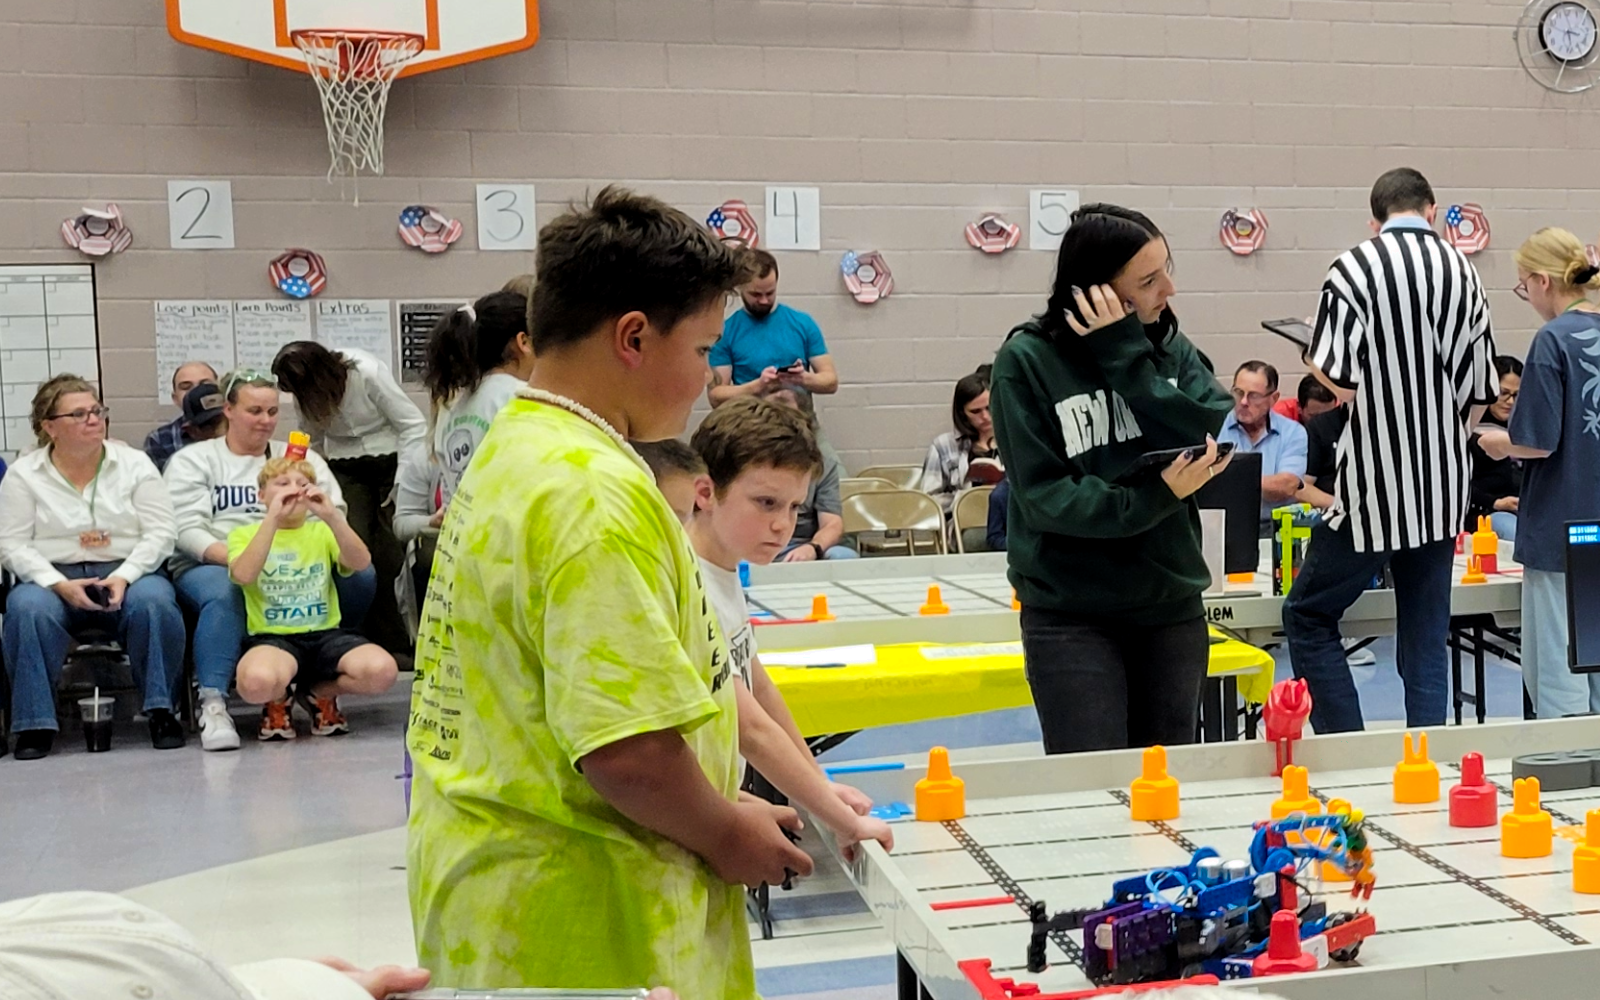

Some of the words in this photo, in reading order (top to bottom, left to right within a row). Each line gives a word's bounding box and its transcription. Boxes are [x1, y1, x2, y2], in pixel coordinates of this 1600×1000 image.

[175, 187, 223, 240] 2
[484, 190, 524, 242] 3
[773, 190, 799, 244] 4
[1037, 192, 1071, 236] 5
[156, 302, 187, 313] Lose
[192, 303, 229, 317] points
[265, 302, 301, 313] Points
[319, 302, 370, 314] Extras
[1054, 388, 1110, 459] NEW
[264, 602, 328, 621] STATE
[1203, 606, 1234, 622] LeM
